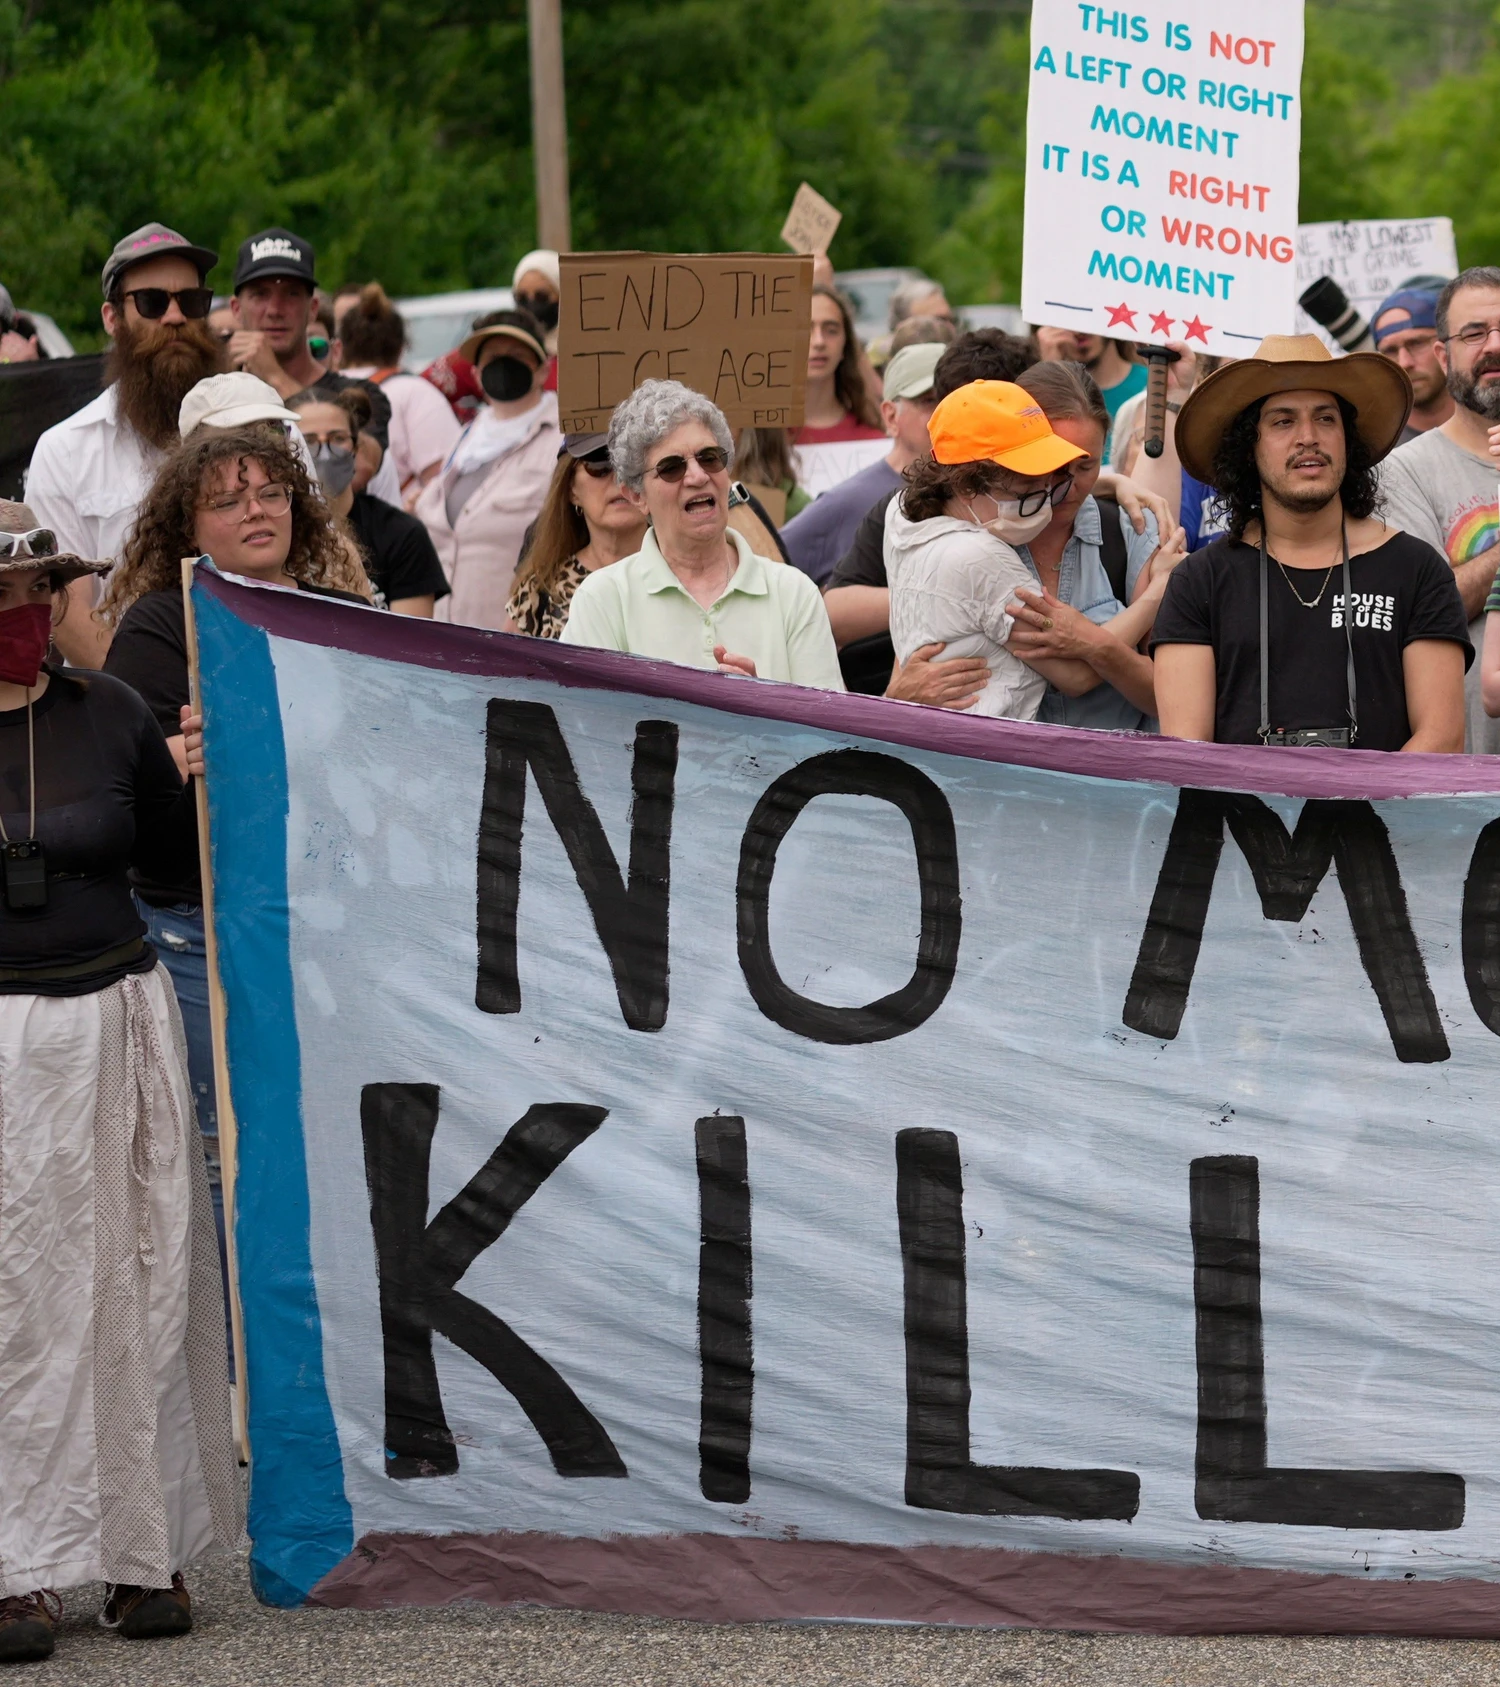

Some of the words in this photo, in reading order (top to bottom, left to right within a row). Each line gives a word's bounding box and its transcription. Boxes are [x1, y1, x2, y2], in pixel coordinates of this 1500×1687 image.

[1078, 4, 1149, 43] THIS
[1165, 21, 1191, 52] IS
[1210, 31, 1275, 67] NOT
[1034, 46, 1056, 74] A
[1065, 51, 1131, 88] LEFT
[1142, 67, 1186, 100] OR
[1198, 79, 1293, 120] RIGHT
[1090, 104, 1239, 158] MOMENT
[1042, 144, 1069, 172] IT
[1081, 151, 1109, 181] IS
[1117, 160, 1140, 188] A
[1169, 170, 1270, 212] RIGHT
[1101, 205, 1146, 238] OR
[1162, 215, 1293, 263] WRONG
[1364, 246, 1422, 274] CRIME
[1366, 222, 1437, 250] LOWEST
[578, 264, 704, 332] END
[720, 270, 795, 319] THE
[1087, 250, 1235, 300] MOMENT
[571, 348, 691, 412] ICE
[714, 349, 792, 403] AGE
[563, 415, 598, 432] FDT
[754, 407, 790, 424] FDT
[1331, 612, 1392, 631] BUES
[1333, 593, 1395, 610] HOUSE
[472, 698, 960, 1046] NO
